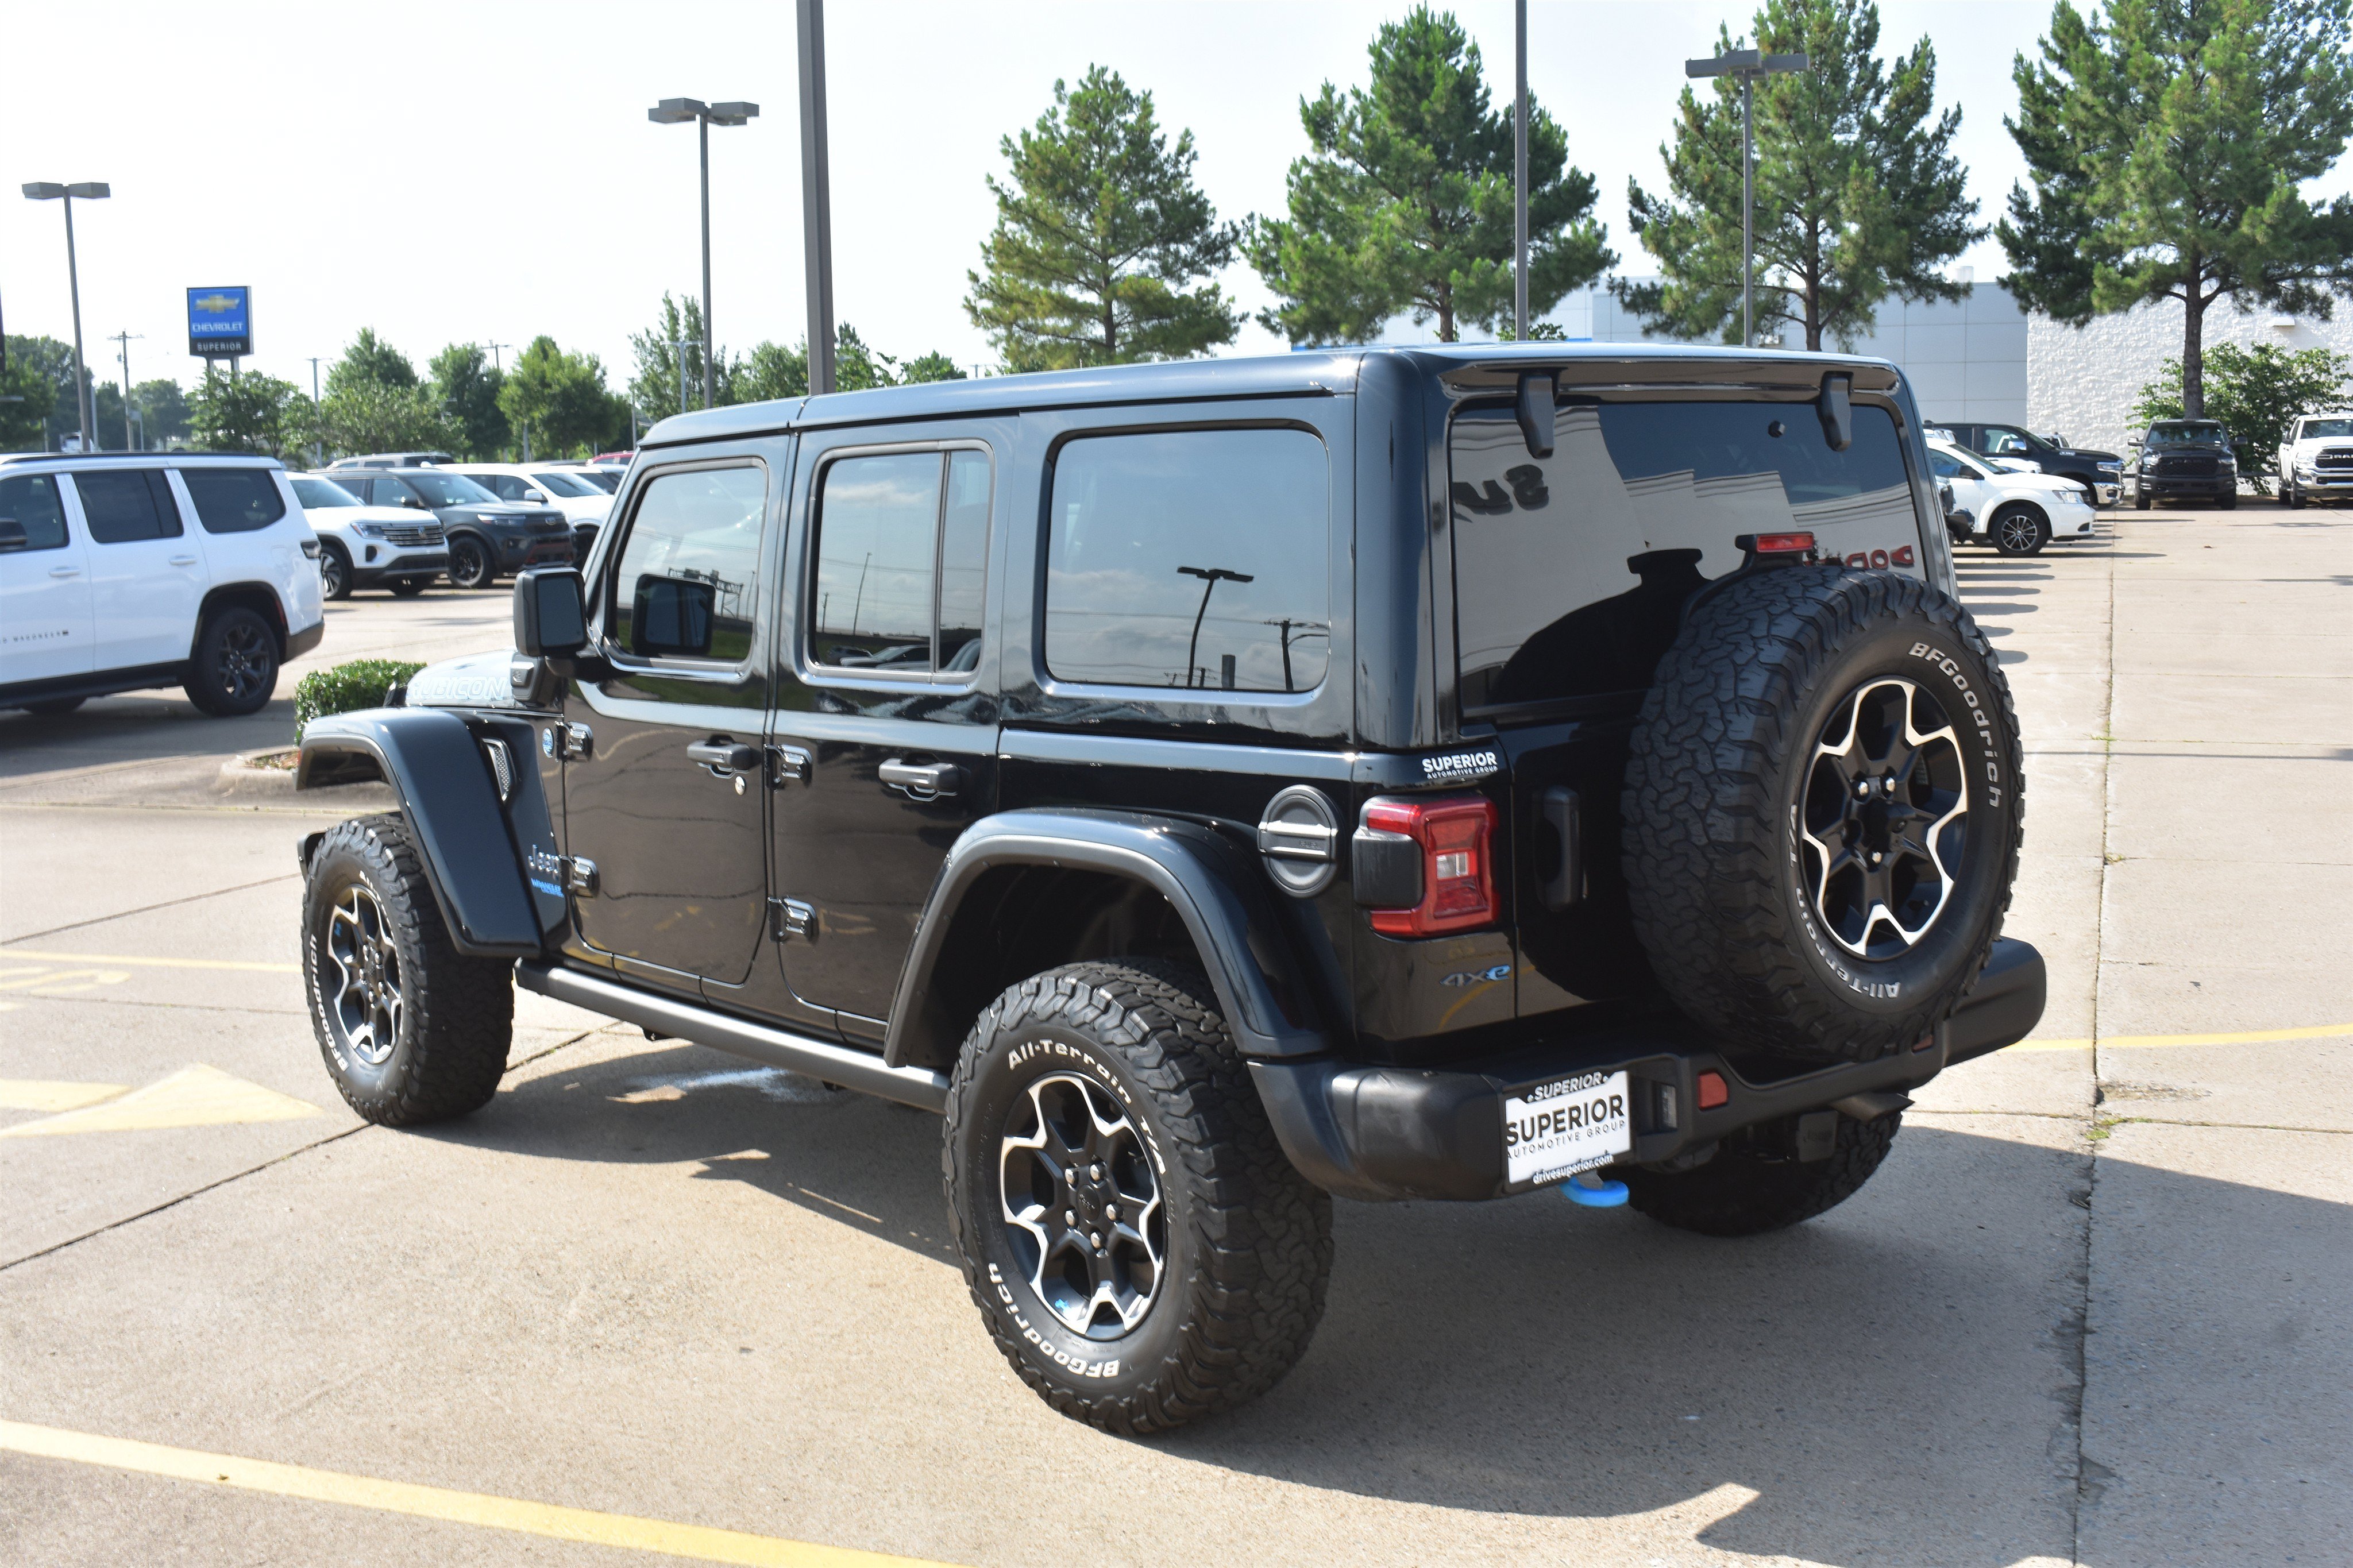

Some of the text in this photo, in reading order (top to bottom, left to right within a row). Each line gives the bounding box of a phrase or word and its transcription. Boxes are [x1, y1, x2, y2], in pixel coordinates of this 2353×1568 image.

[192, 322, 244, 333] CHEVROLET
[197, 341, 242, 352] SUPERIOR
[406, 676, 508, 700] RUBICON
[1908, 642, 2002, 808] BFGoodrich
[1422, 751, 1498, 773] SUPERIOR
[1426, 765, 1498, 779] AUTOMOTIVE GROUP
[528, 844, 560, 880] Jeep
[310, 933, 349, 1072] BFGoodrich
[1534, 1072, 1602, 1101] SUPERIOR
[1008, 1039, 1166, 1175] All-Terrain T/A
[1507, 1094, 1625, 1146] SUPERIOR
[1507, 1120, 1625, 1159] AUTOMOTIVE GROUP
[1533, 1153, 1614, 1185] drivesuperior.com
[989, 1263, 1120, 1377] BFGoodrich
